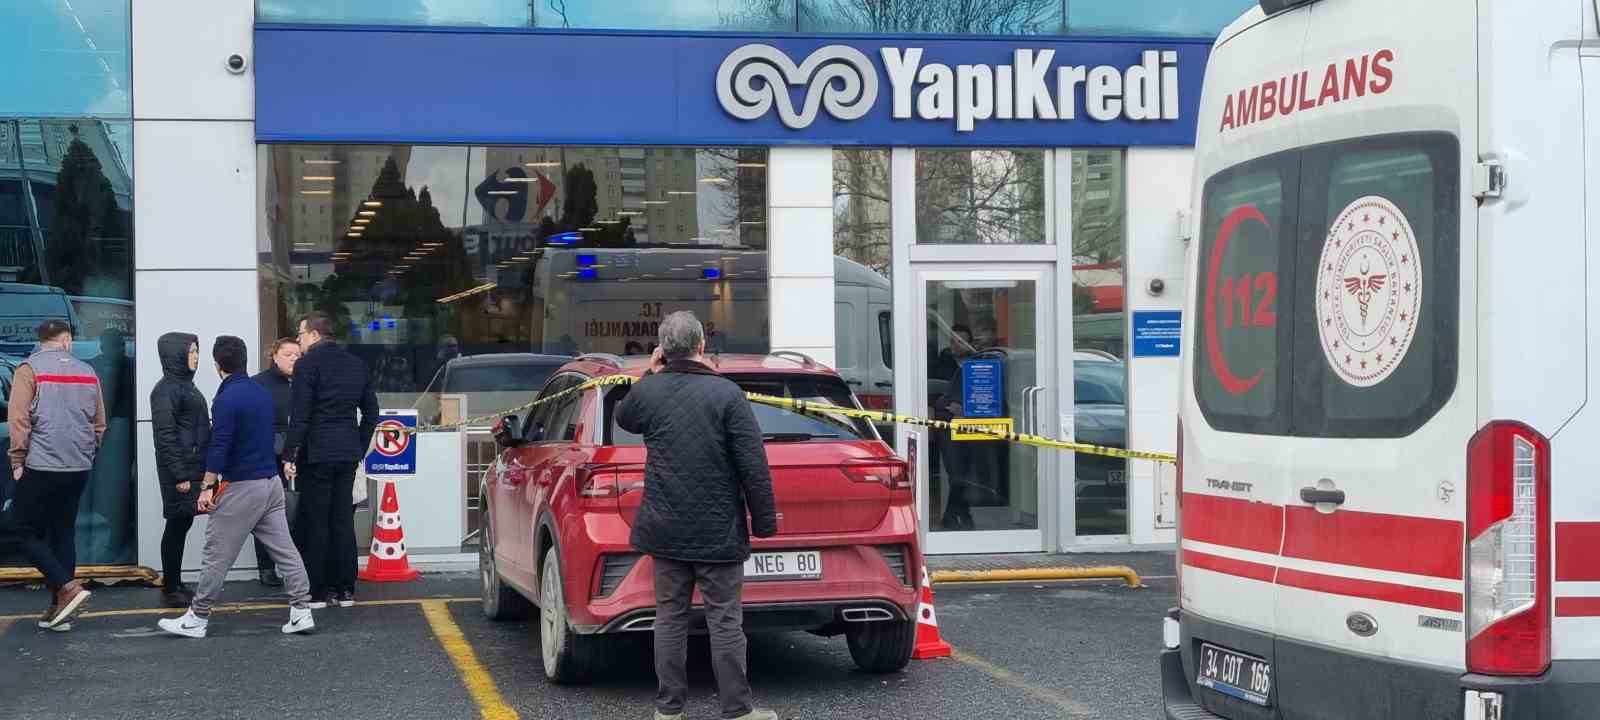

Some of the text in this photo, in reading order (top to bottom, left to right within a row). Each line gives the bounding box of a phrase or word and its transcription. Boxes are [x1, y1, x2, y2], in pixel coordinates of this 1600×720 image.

[880, 47, 1179, 132] YapıKredi
[1219, 49, 1394, 132] AMBULANS
[1221, 271, 1279, 329] 112
[754, 554, 817, 573] NEG 80
[1206, 649, 1218, 678] 34
[1223, 654, 1243, 685] COT
[1250, 662, 1270, 693] 166
